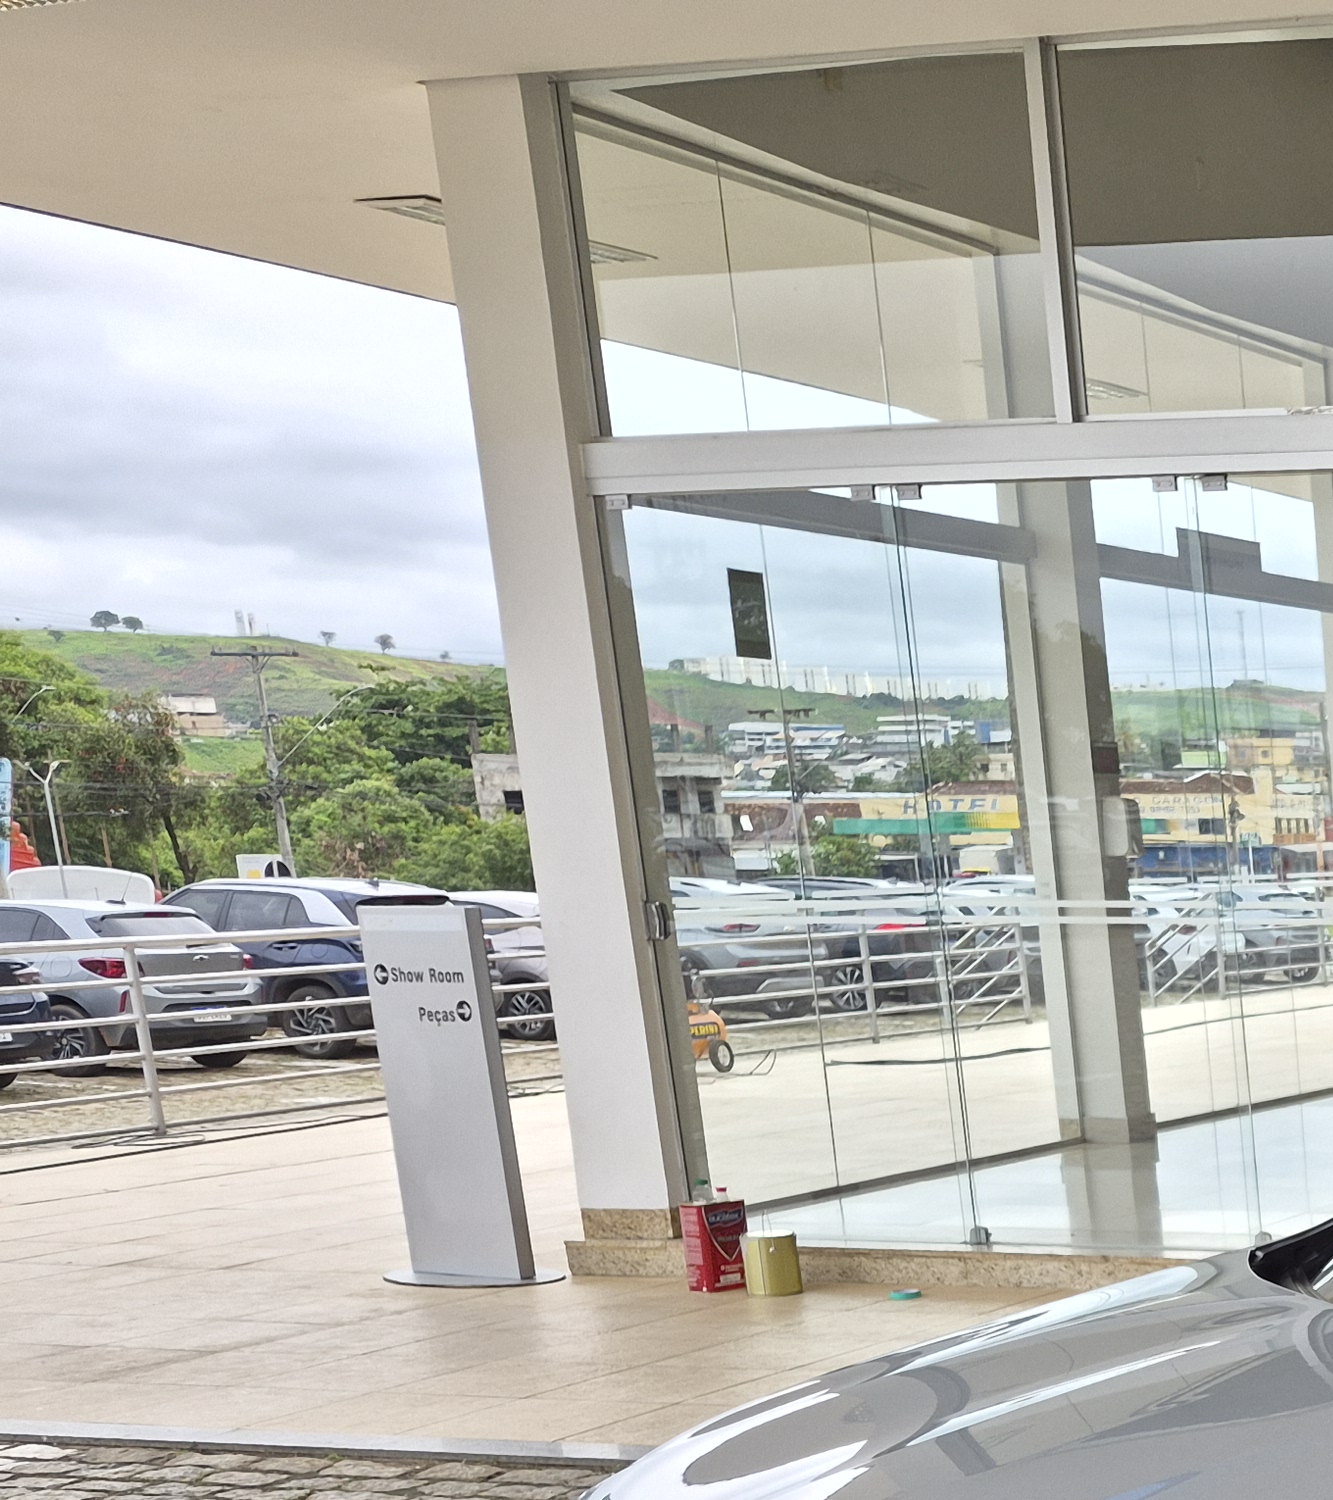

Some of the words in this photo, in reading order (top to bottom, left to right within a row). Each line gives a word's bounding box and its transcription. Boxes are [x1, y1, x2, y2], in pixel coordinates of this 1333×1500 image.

[390, 966, 424, 983] Show
[428, 967, 465, 984] Room
[418, 1006, 456, 1027] Peças
